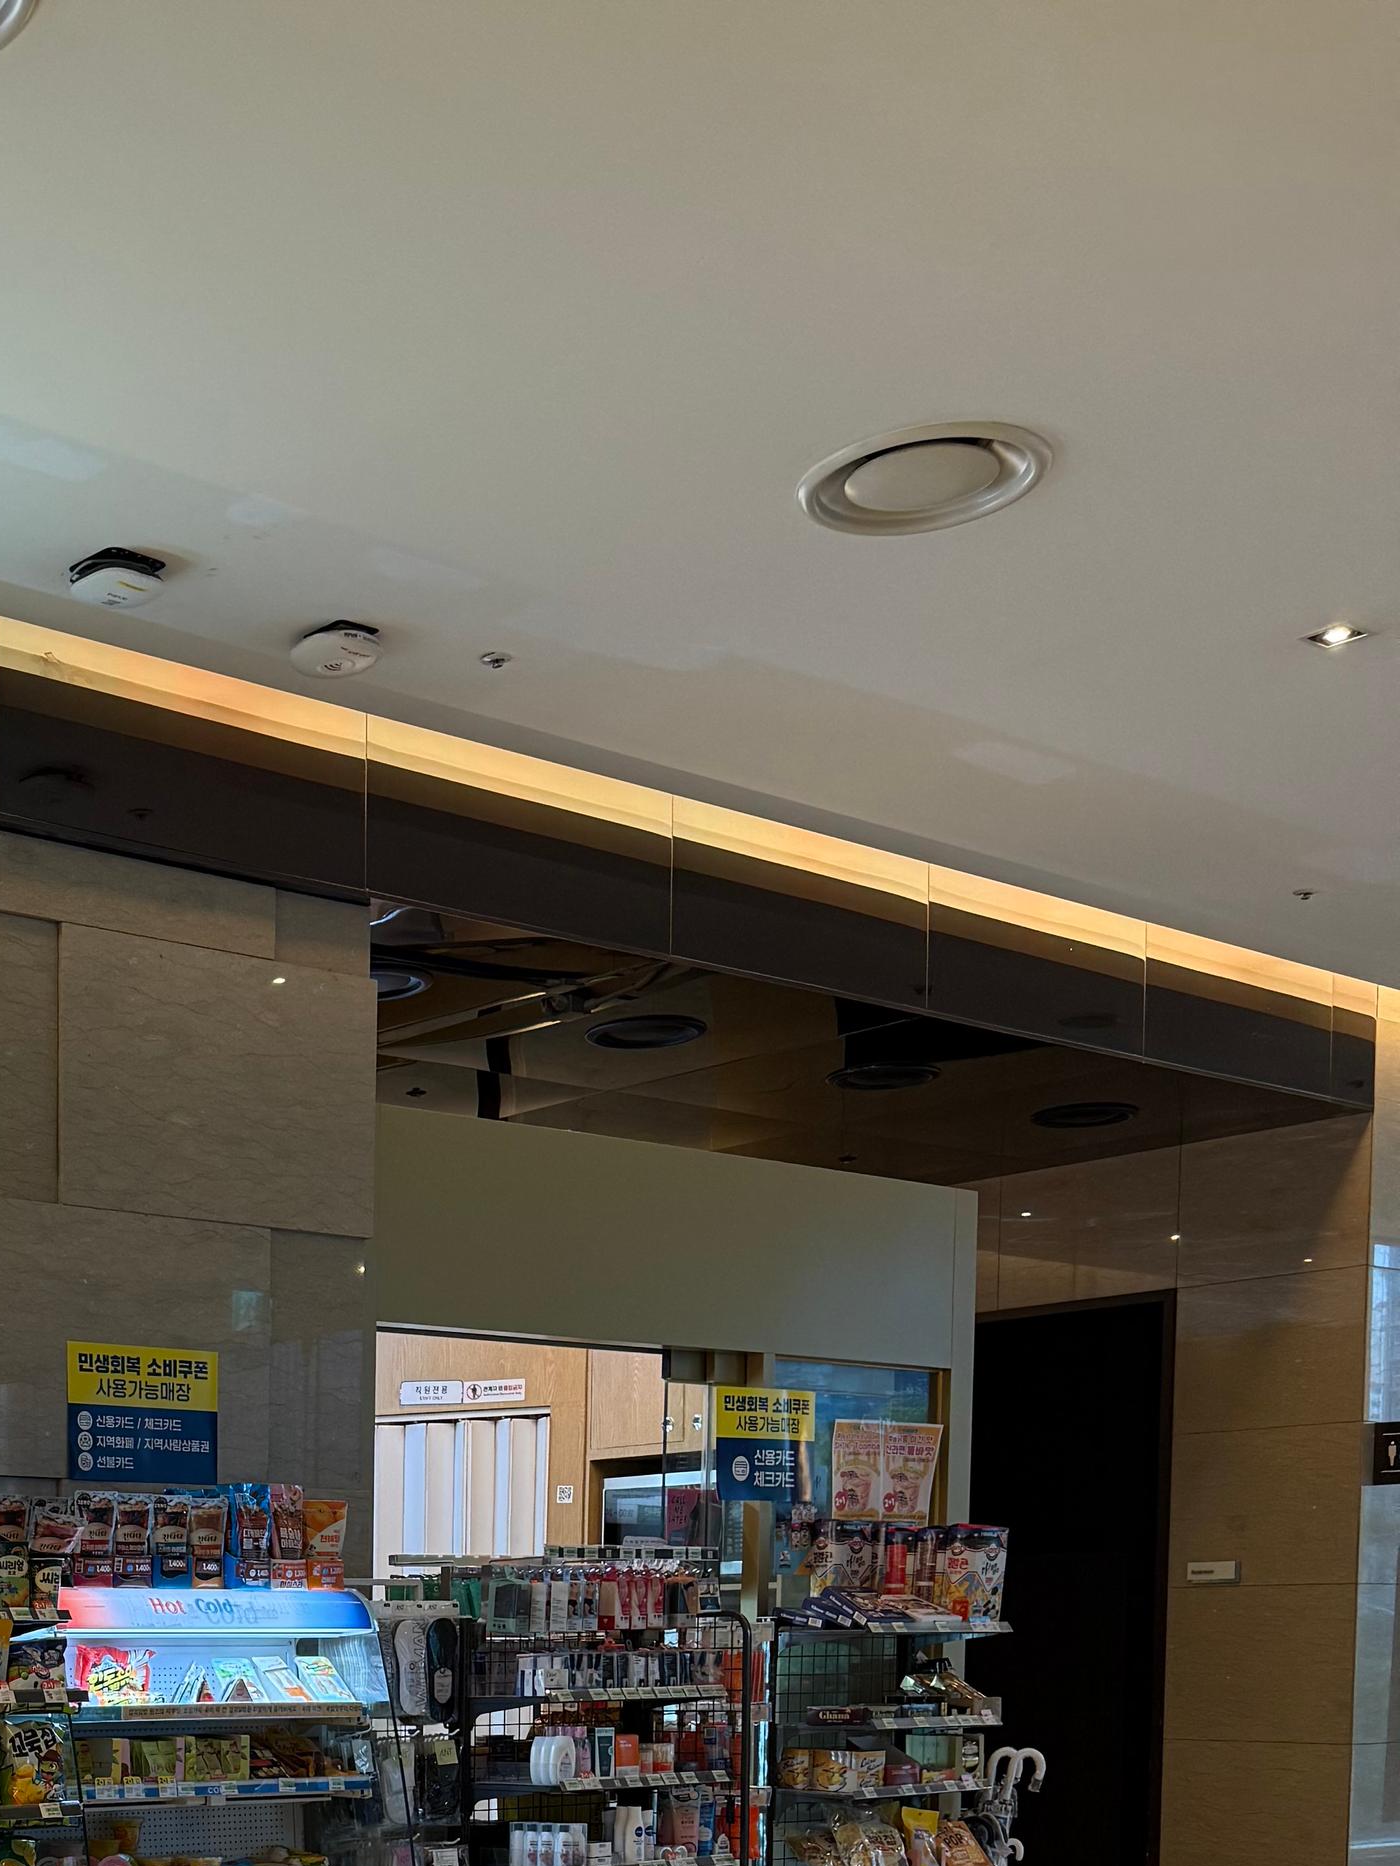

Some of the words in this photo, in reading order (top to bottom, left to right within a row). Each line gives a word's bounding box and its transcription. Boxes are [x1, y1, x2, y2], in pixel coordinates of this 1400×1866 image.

[77, 1352, 141, 1377] 민생회복
[146, 1357, 210, 1381] 소비쿠폰
[95, 1377, 192, 1402] 사용가능매장
[723, 1394, 769, 1414] 민생회복
[772, 1397, 811, 1416] 소비쿠폰
[95, 1414, 135, 1430] 신용카드
[143, 1416, 183, 1433] 체크카드
[95, 1434, 135, 1450] 지역화폐
[143, 1437, 210, 1454] 지역사랑상품권
[96, 1455, 135, 1470] 선불카드
[753, 1449, 796, 1467] 신용카드
[753, 1470, 796, 1489] 체크카드
[147, 1597, 187, 1616] Hot
[194, 1598, 235, 1616] Cold
[818, 1710, 851, 1721] Ghana
